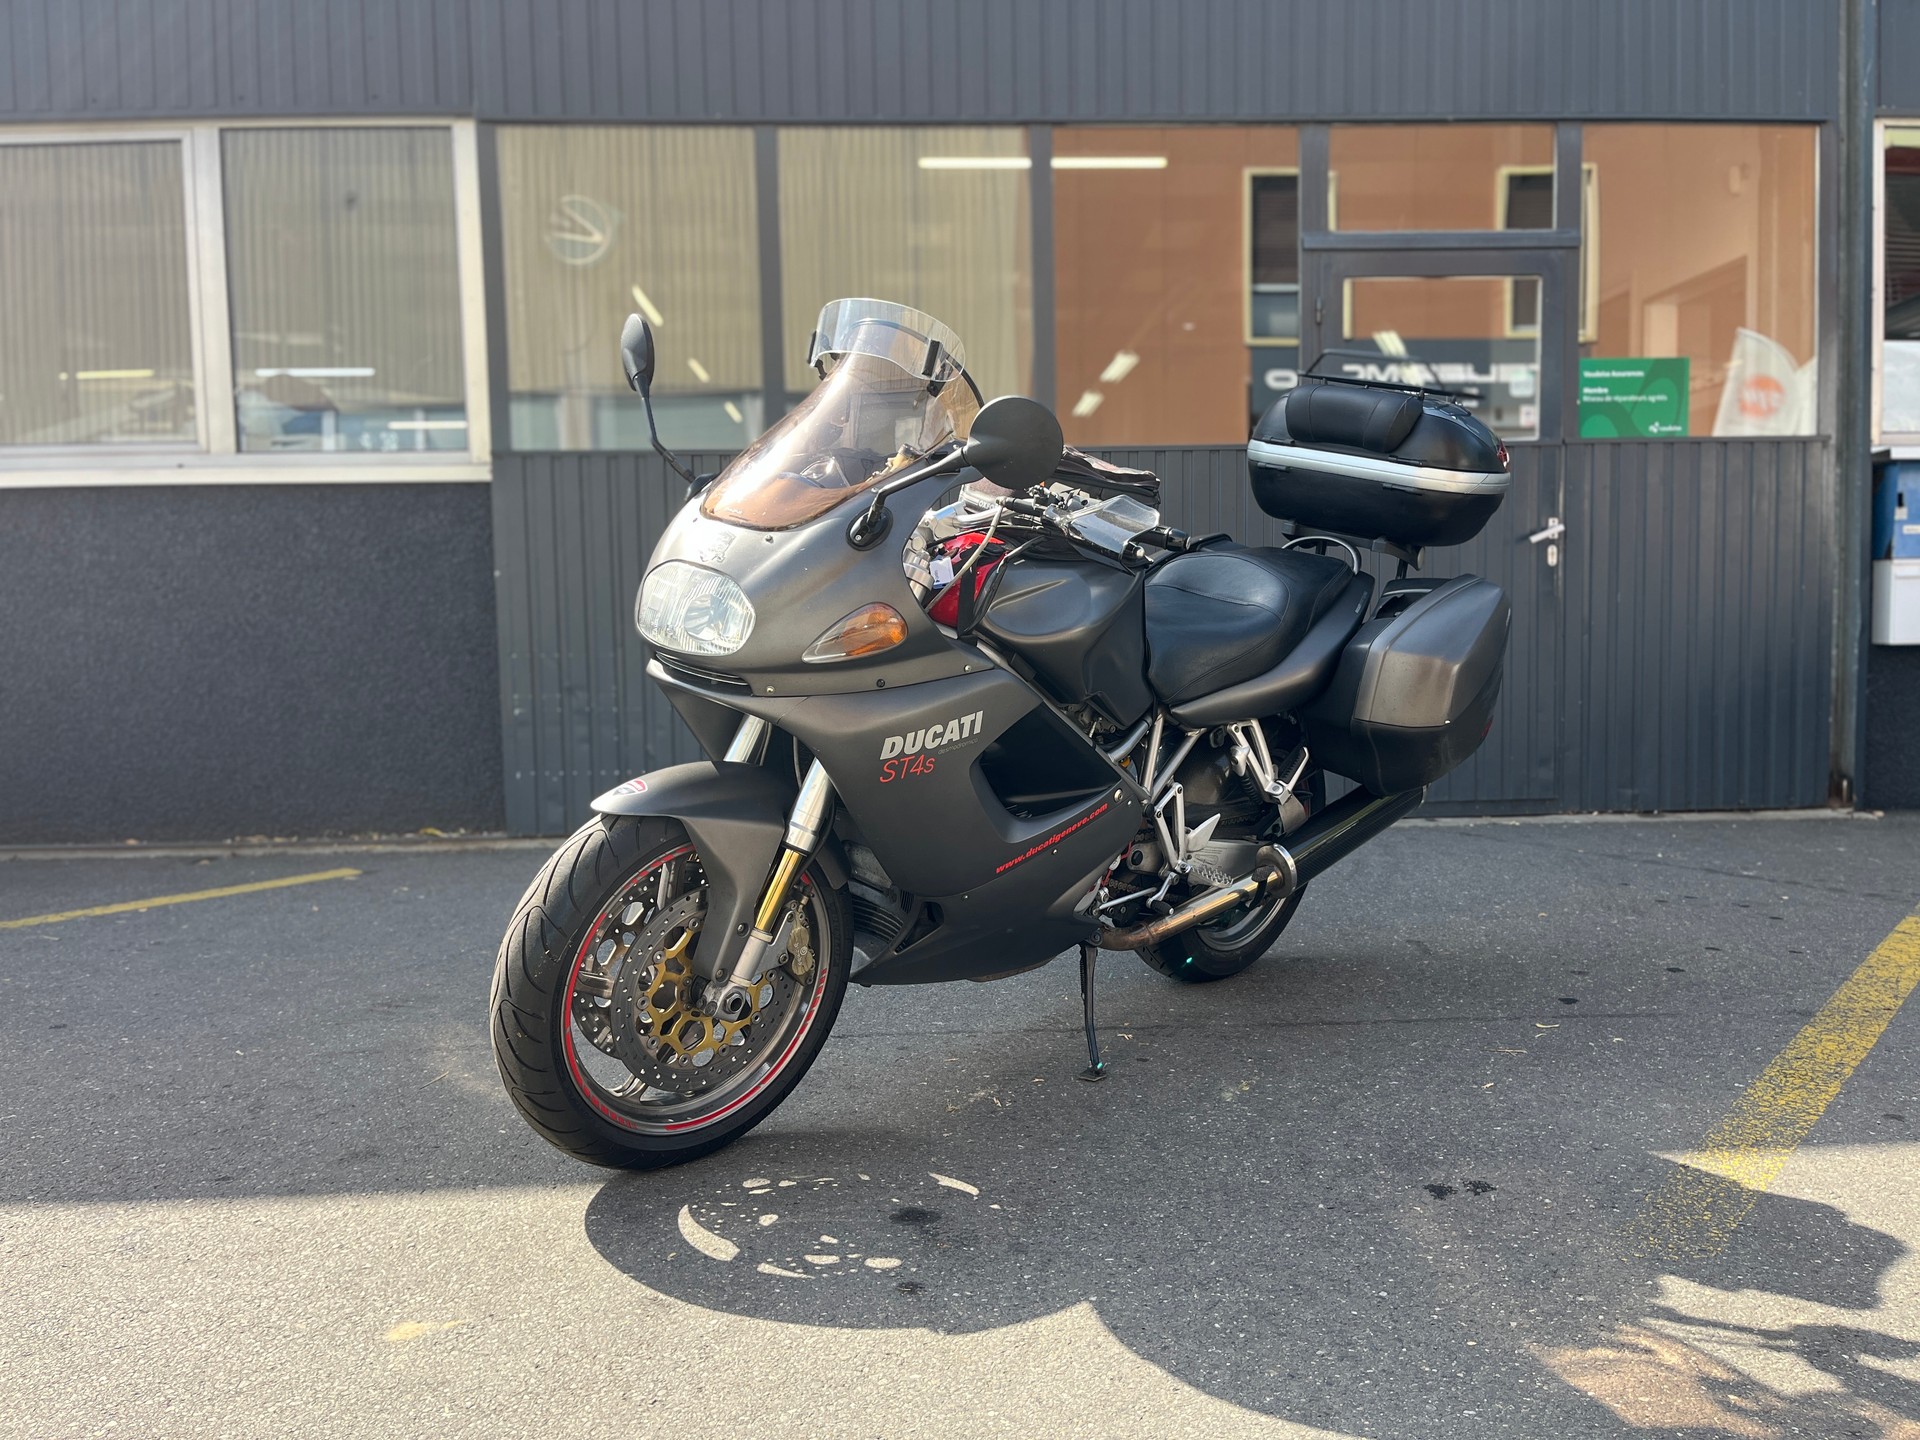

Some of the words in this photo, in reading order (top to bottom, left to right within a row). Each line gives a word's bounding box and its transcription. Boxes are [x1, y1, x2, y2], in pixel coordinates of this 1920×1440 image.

[880, 710, 983, 760] DUCATI
[880, 754, 935, 783] ST4s
[996, 803, 1108, 874] www.ducatigeneve.com
